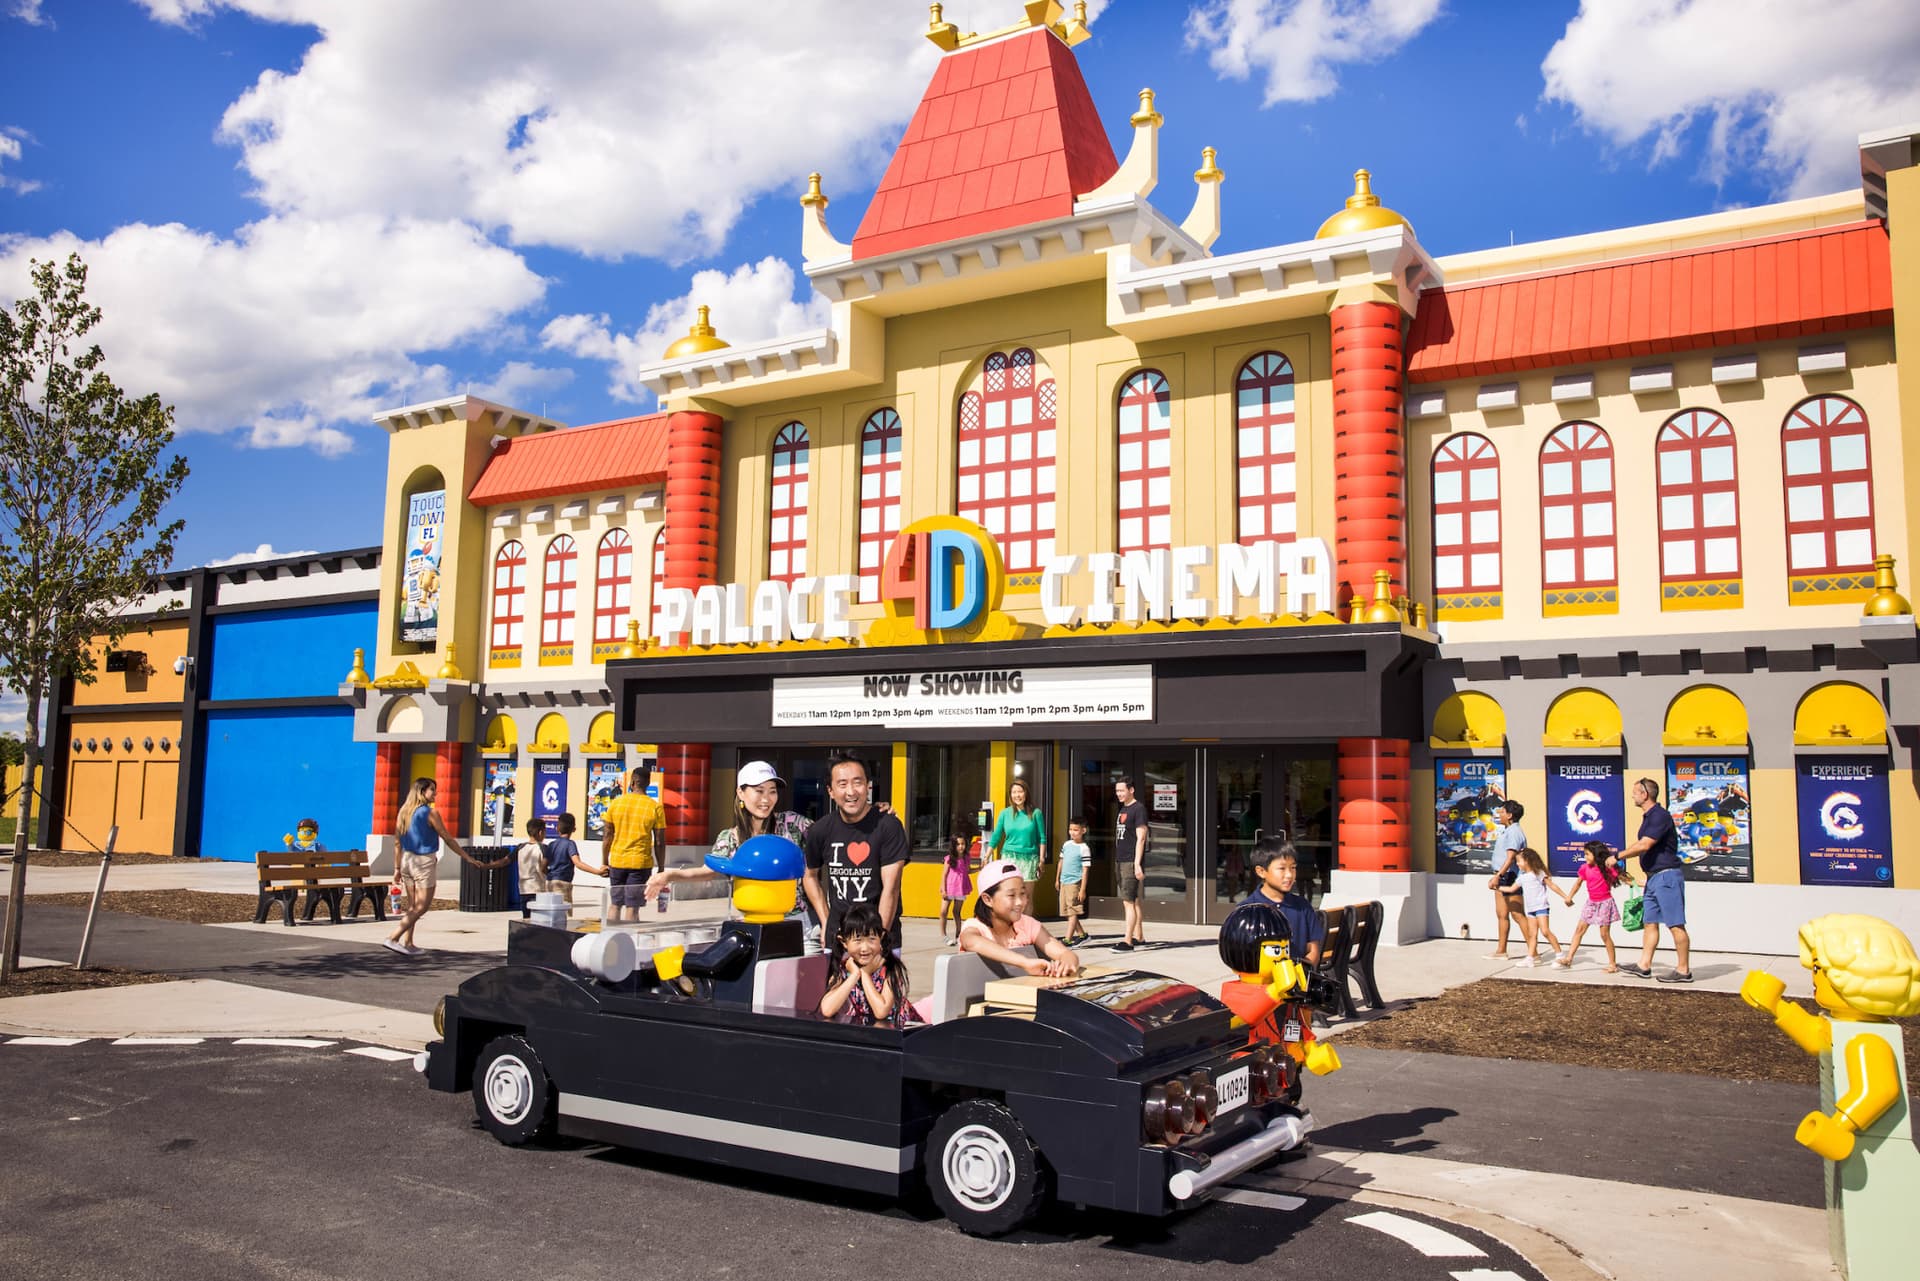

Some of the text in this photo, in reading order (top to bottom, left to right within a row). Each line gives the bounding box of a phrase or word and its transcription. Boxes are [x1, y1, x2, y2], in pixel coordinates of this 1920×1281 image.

[655, 528, 1336, 647] PALACE 4D CINEMA
[863, 670, 1024, 698] NOW SHOWING
[777, 702, 1145, 720] WEEKDAYS 11am 12pm 1pm 2pm 3pm 4pm WEEKENDS 11am 12pm 1pm 2pm 3pm 4pm 5pm
[1463, 763, 1492, 776] CITY
[1559, 765, 1612, 776] EXPERIENCE
[1698, 762, 1732, 775] CITY
[1811, 765, 1873, 776] EXPERIENCE
[828, 842, 844, 867] I
[830, 876, 872, 902] NY
